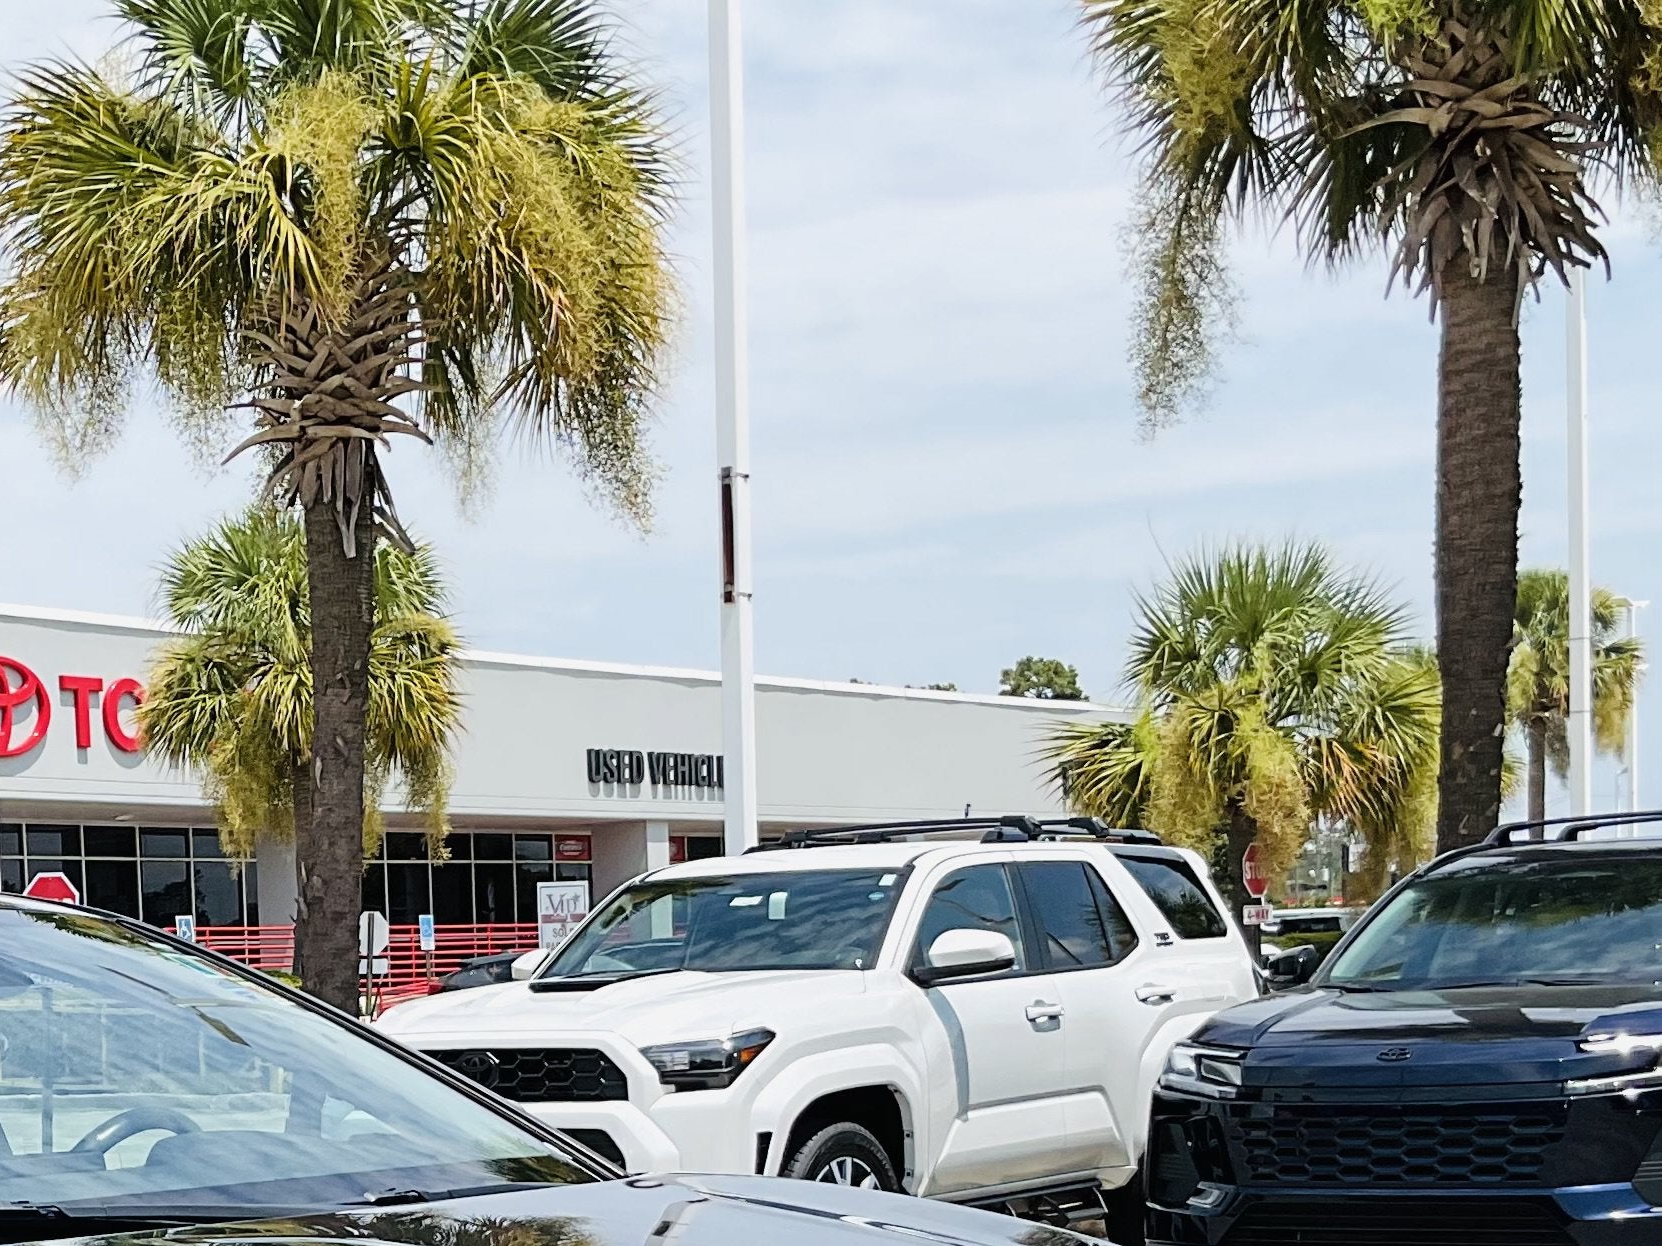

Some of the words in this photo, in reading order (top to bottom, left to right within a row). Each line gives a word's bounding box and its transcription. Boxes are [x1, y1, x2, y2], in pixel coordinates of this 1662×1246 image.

[58, 674, 148, 752] TO
[586, 748, 645, 784] USED
[646, 751, 725, 787] VEHICL
[1245, 861, 1267, 880] STO
[1247, 908, 1269, 921] 4-WAY
[553, 927, 574, 938] SOL
